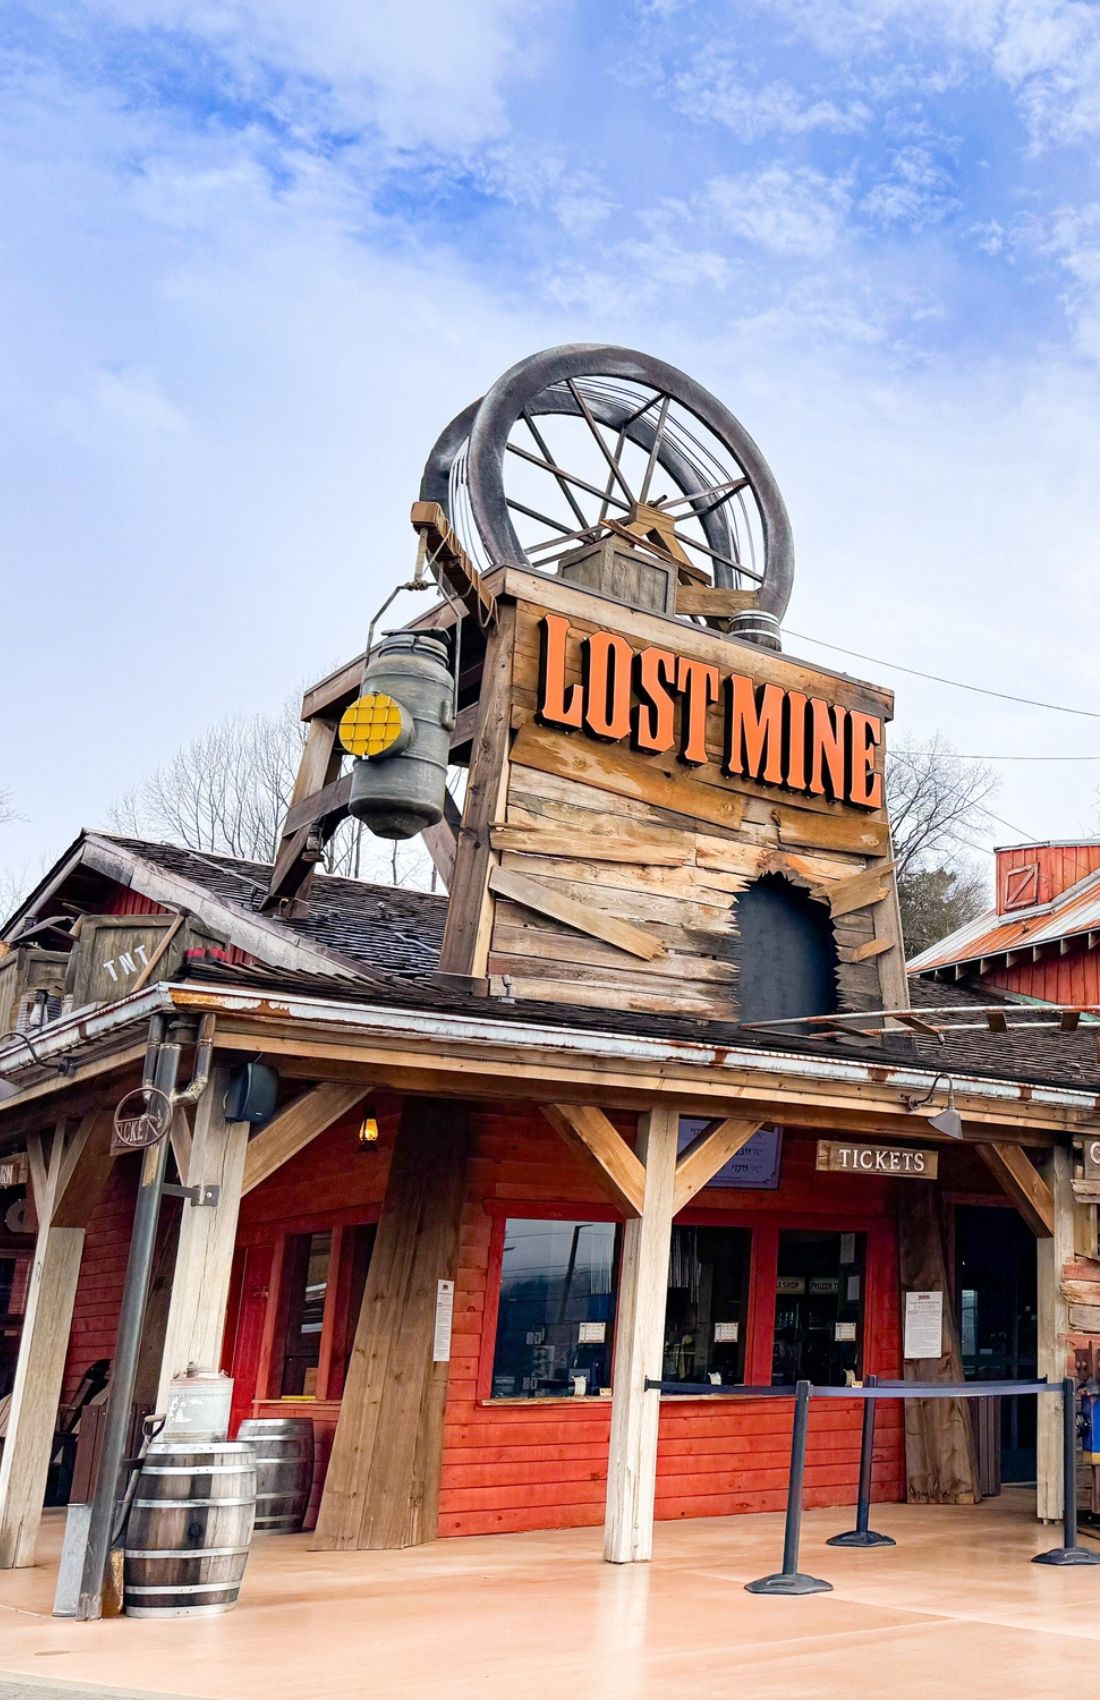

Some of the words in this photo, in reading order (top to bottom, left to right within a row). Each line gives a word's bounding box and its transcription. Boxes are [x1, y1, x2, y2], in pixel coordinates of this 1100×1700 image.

[540, 612, 720, 766] LOST
[726, 671, 883, 810] MINE
[103, 944, 149, 982] TNT
[838, 1148, 925, 1172] TICKETS
